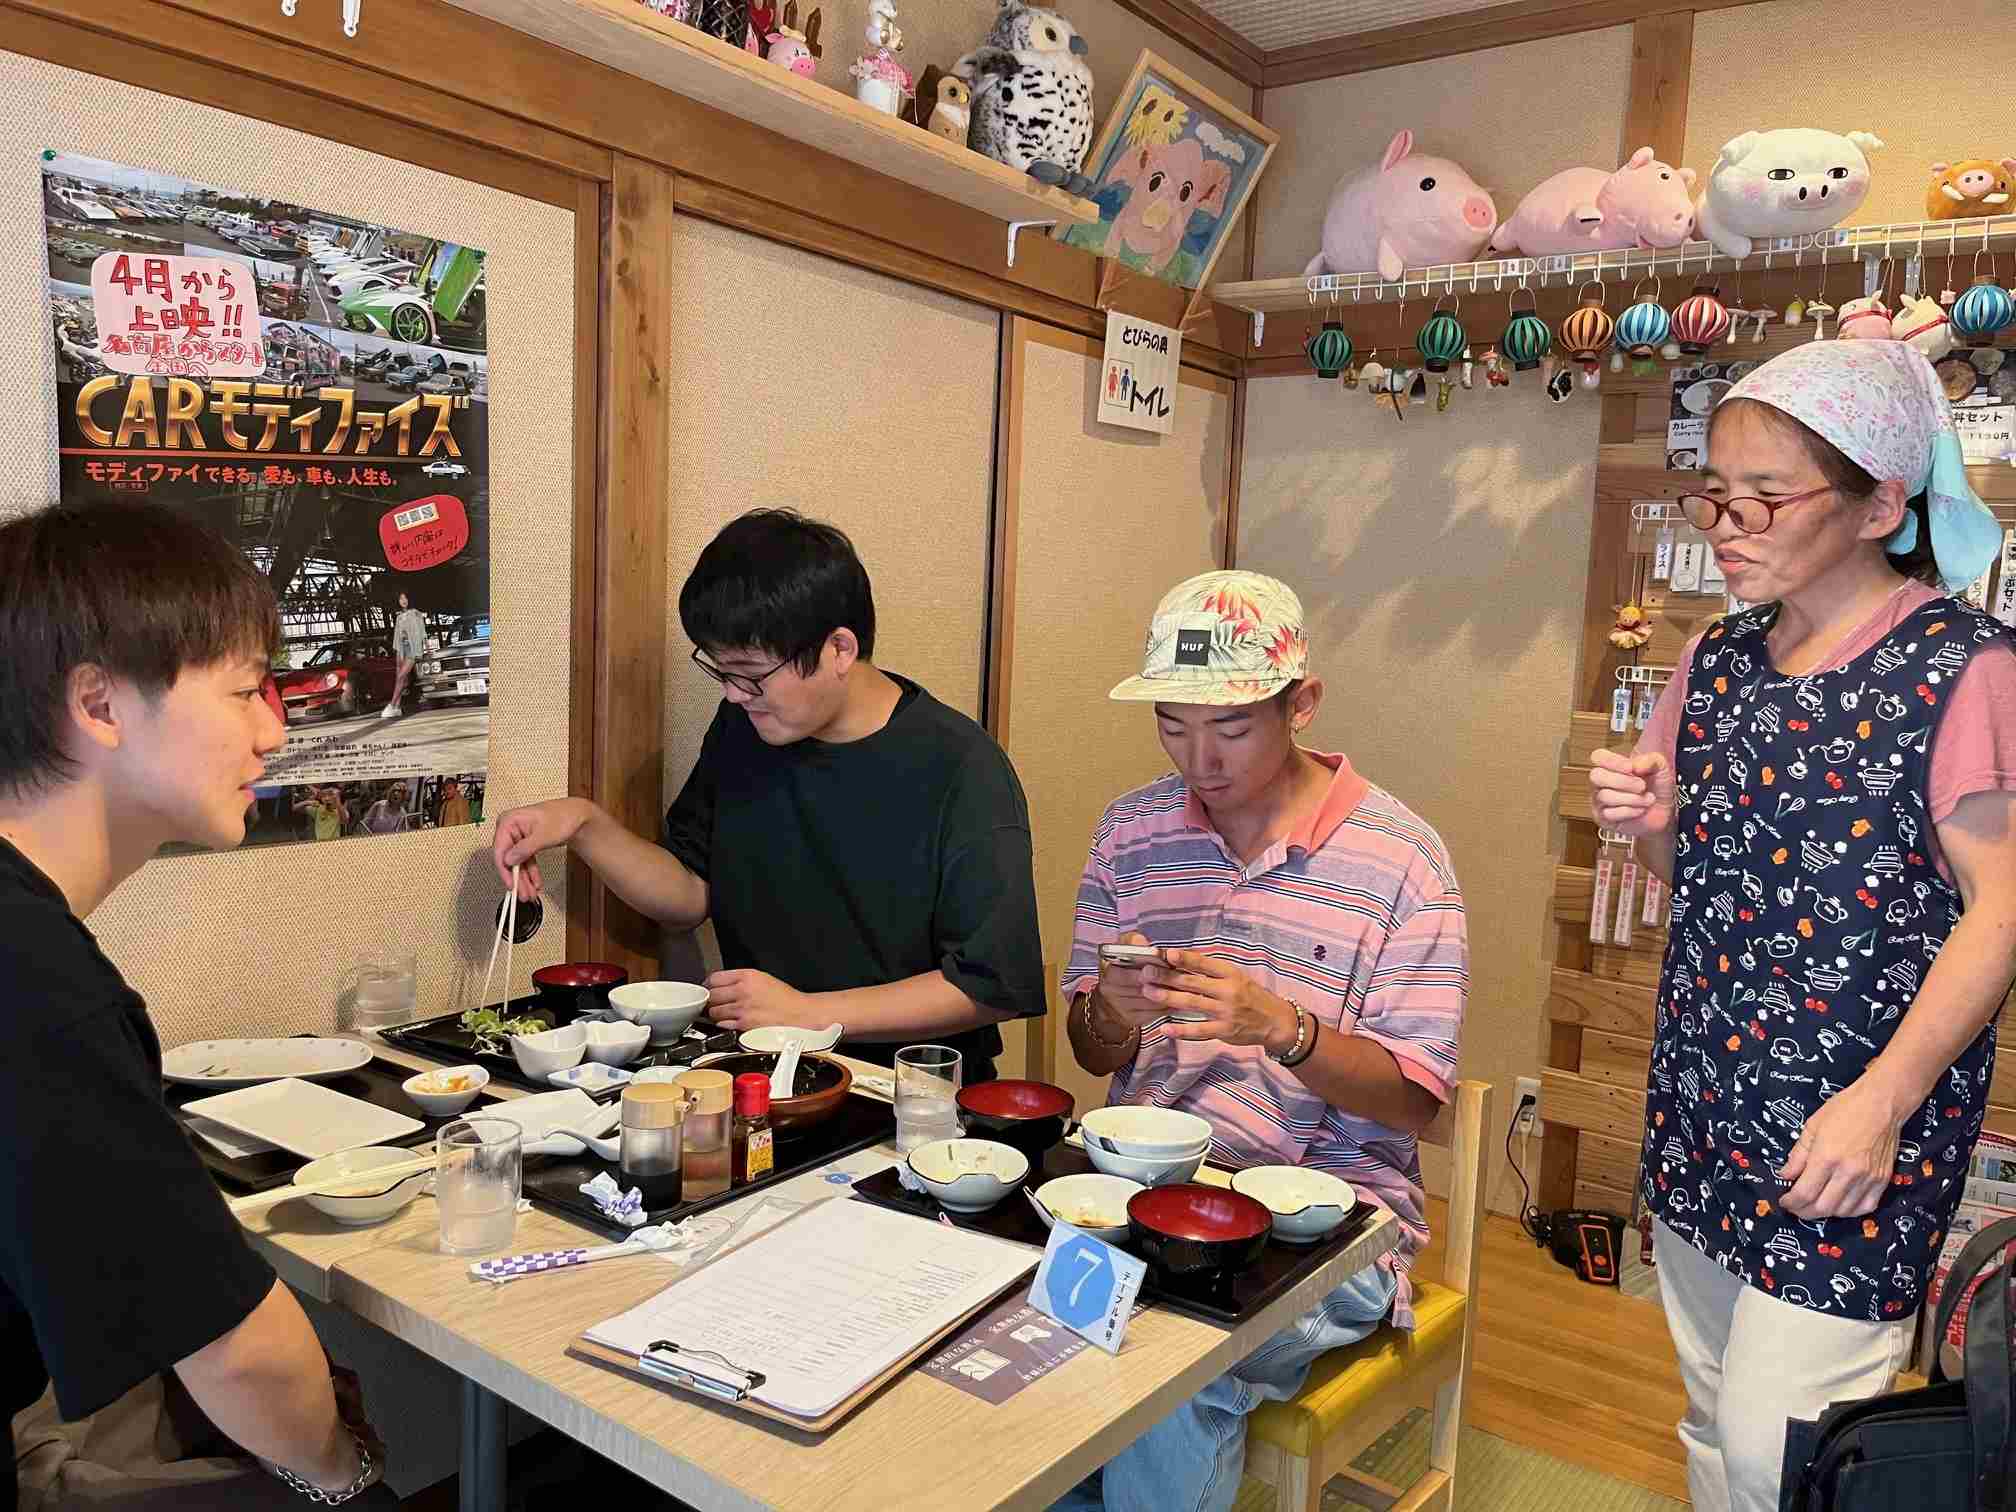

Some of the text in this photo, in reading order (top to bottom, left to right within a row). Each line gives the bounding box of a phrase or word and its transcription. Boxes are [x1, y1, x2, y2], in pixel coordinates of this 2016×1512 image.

[110, 254, 236, 303] 4月から
[1129, 380, 1170, 418] トイレ
[1180, 641, 1204, 652] HUF
[1069, 1247, 1104, 1308] 7
